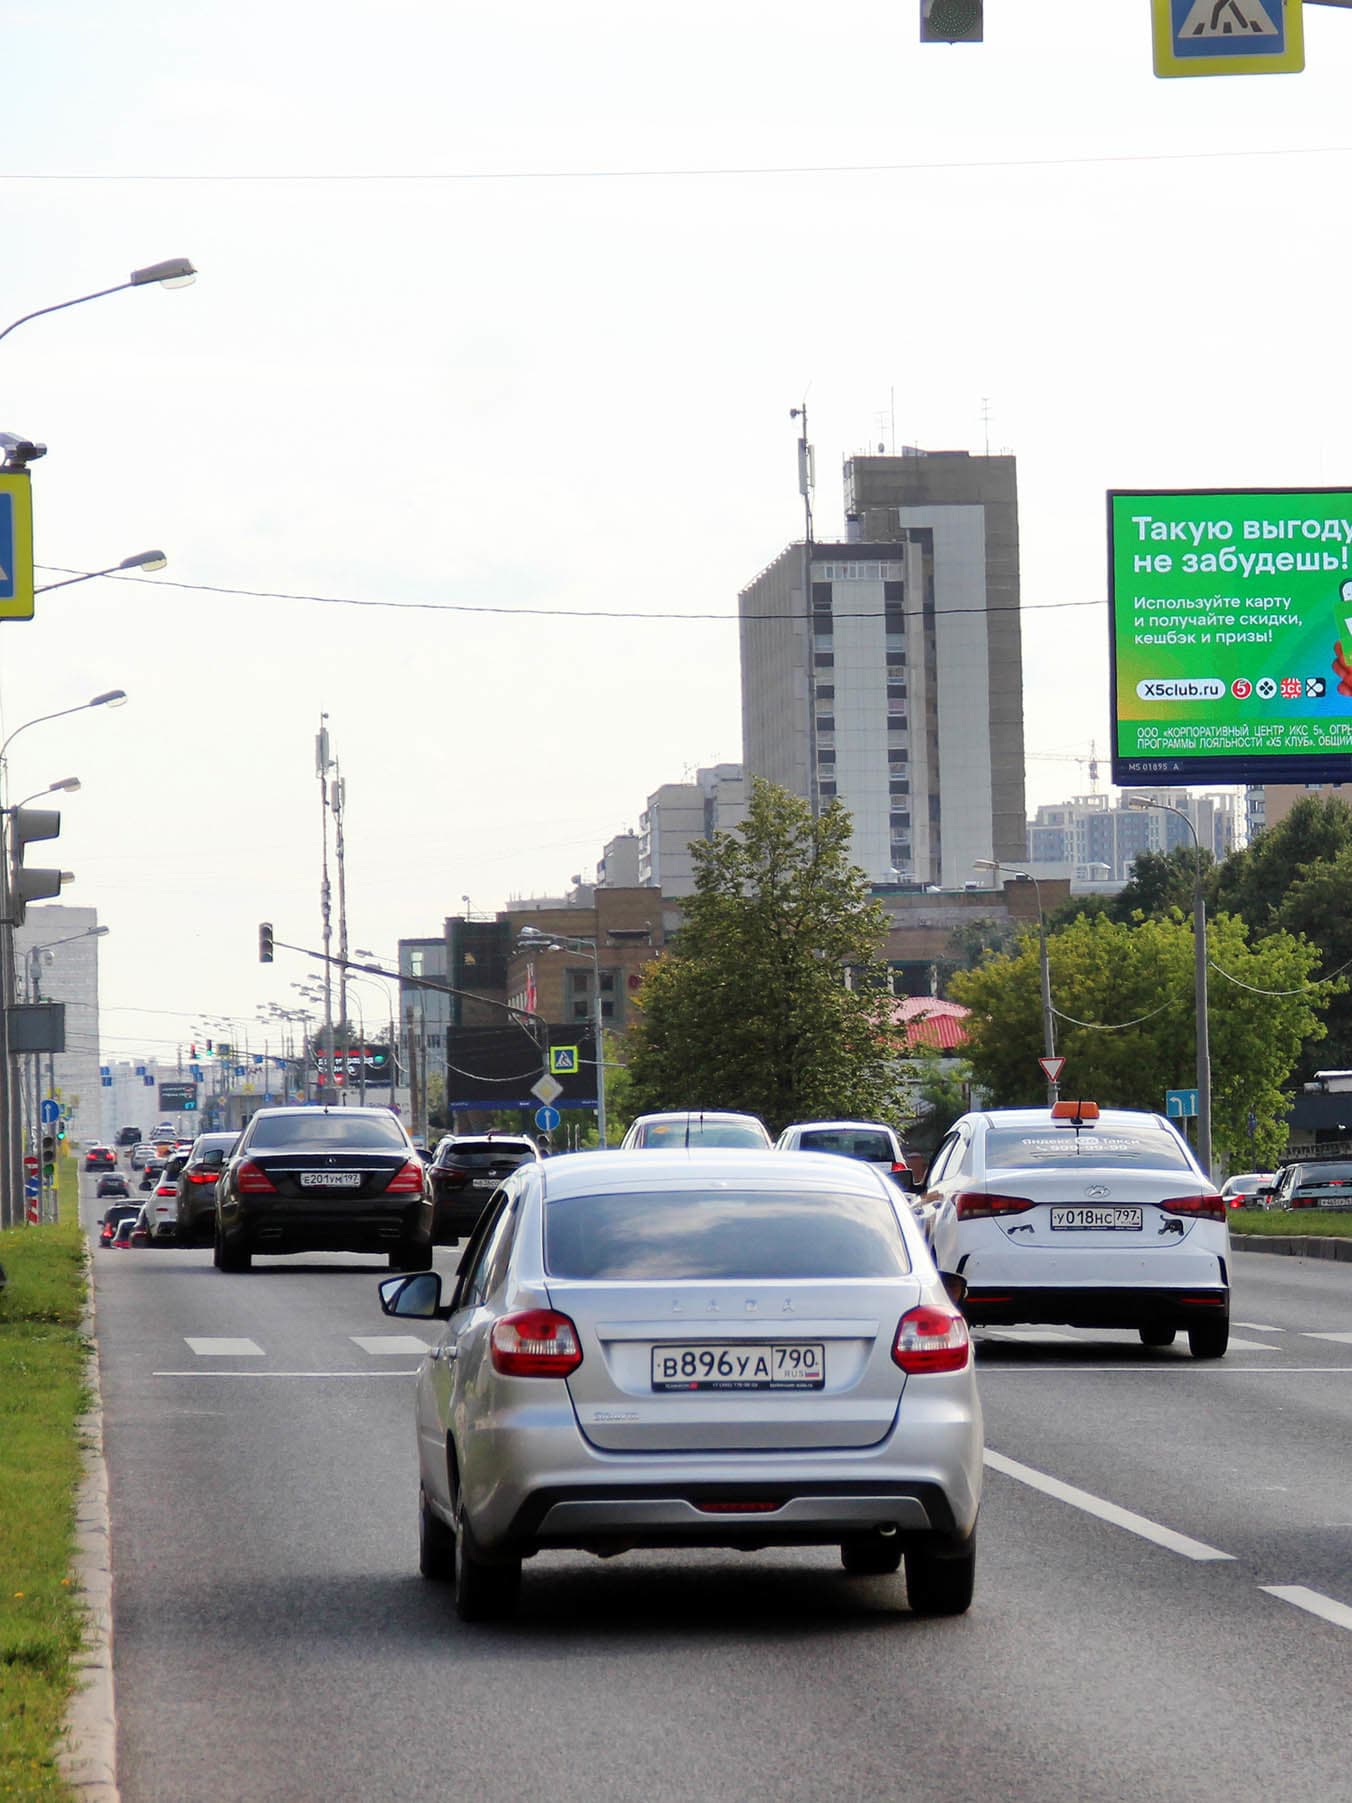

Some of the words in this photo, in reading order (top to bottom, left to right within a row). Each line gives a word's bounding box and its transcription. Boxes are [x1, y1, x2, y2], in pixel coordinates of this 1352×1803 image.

[1131, 515, 1233, 546] Такую
[1133, 553, 1173, 573] не
[1181, 545, 1349, 578] забудешь!
[1133, 595, 1241, 612] Используйте
[1245, 596, 1292, 611] карту
[1134, 616, 1145, 627] и
[1149, 612, 1236, 630] получайте
[1239, 612, 1303, 627] скидки,
[1134, 630, 1197, 645] кешбэк
[1201, 632, 1212, 643] и
[1215, 629, 1273, 646] призы!
[1144, 683, 1219, 697] X5club.ru
[1136, 727, 1159, 738] ООО
[1254, 725, 1285, 737] ЦЕНТР
[1289, 725, 1309, 736] ИКС
[1136, 737, 1197, 749] ПРОГРАММЫ
[1199, 736, 1263, 748] ЛОЯЛЬНОСТИ
[1318, 734, 1352, 746] ОБЩИЙ
[1115, 1209, 1138, 1221] 797
[775, 1348, 816, 1369] 790
